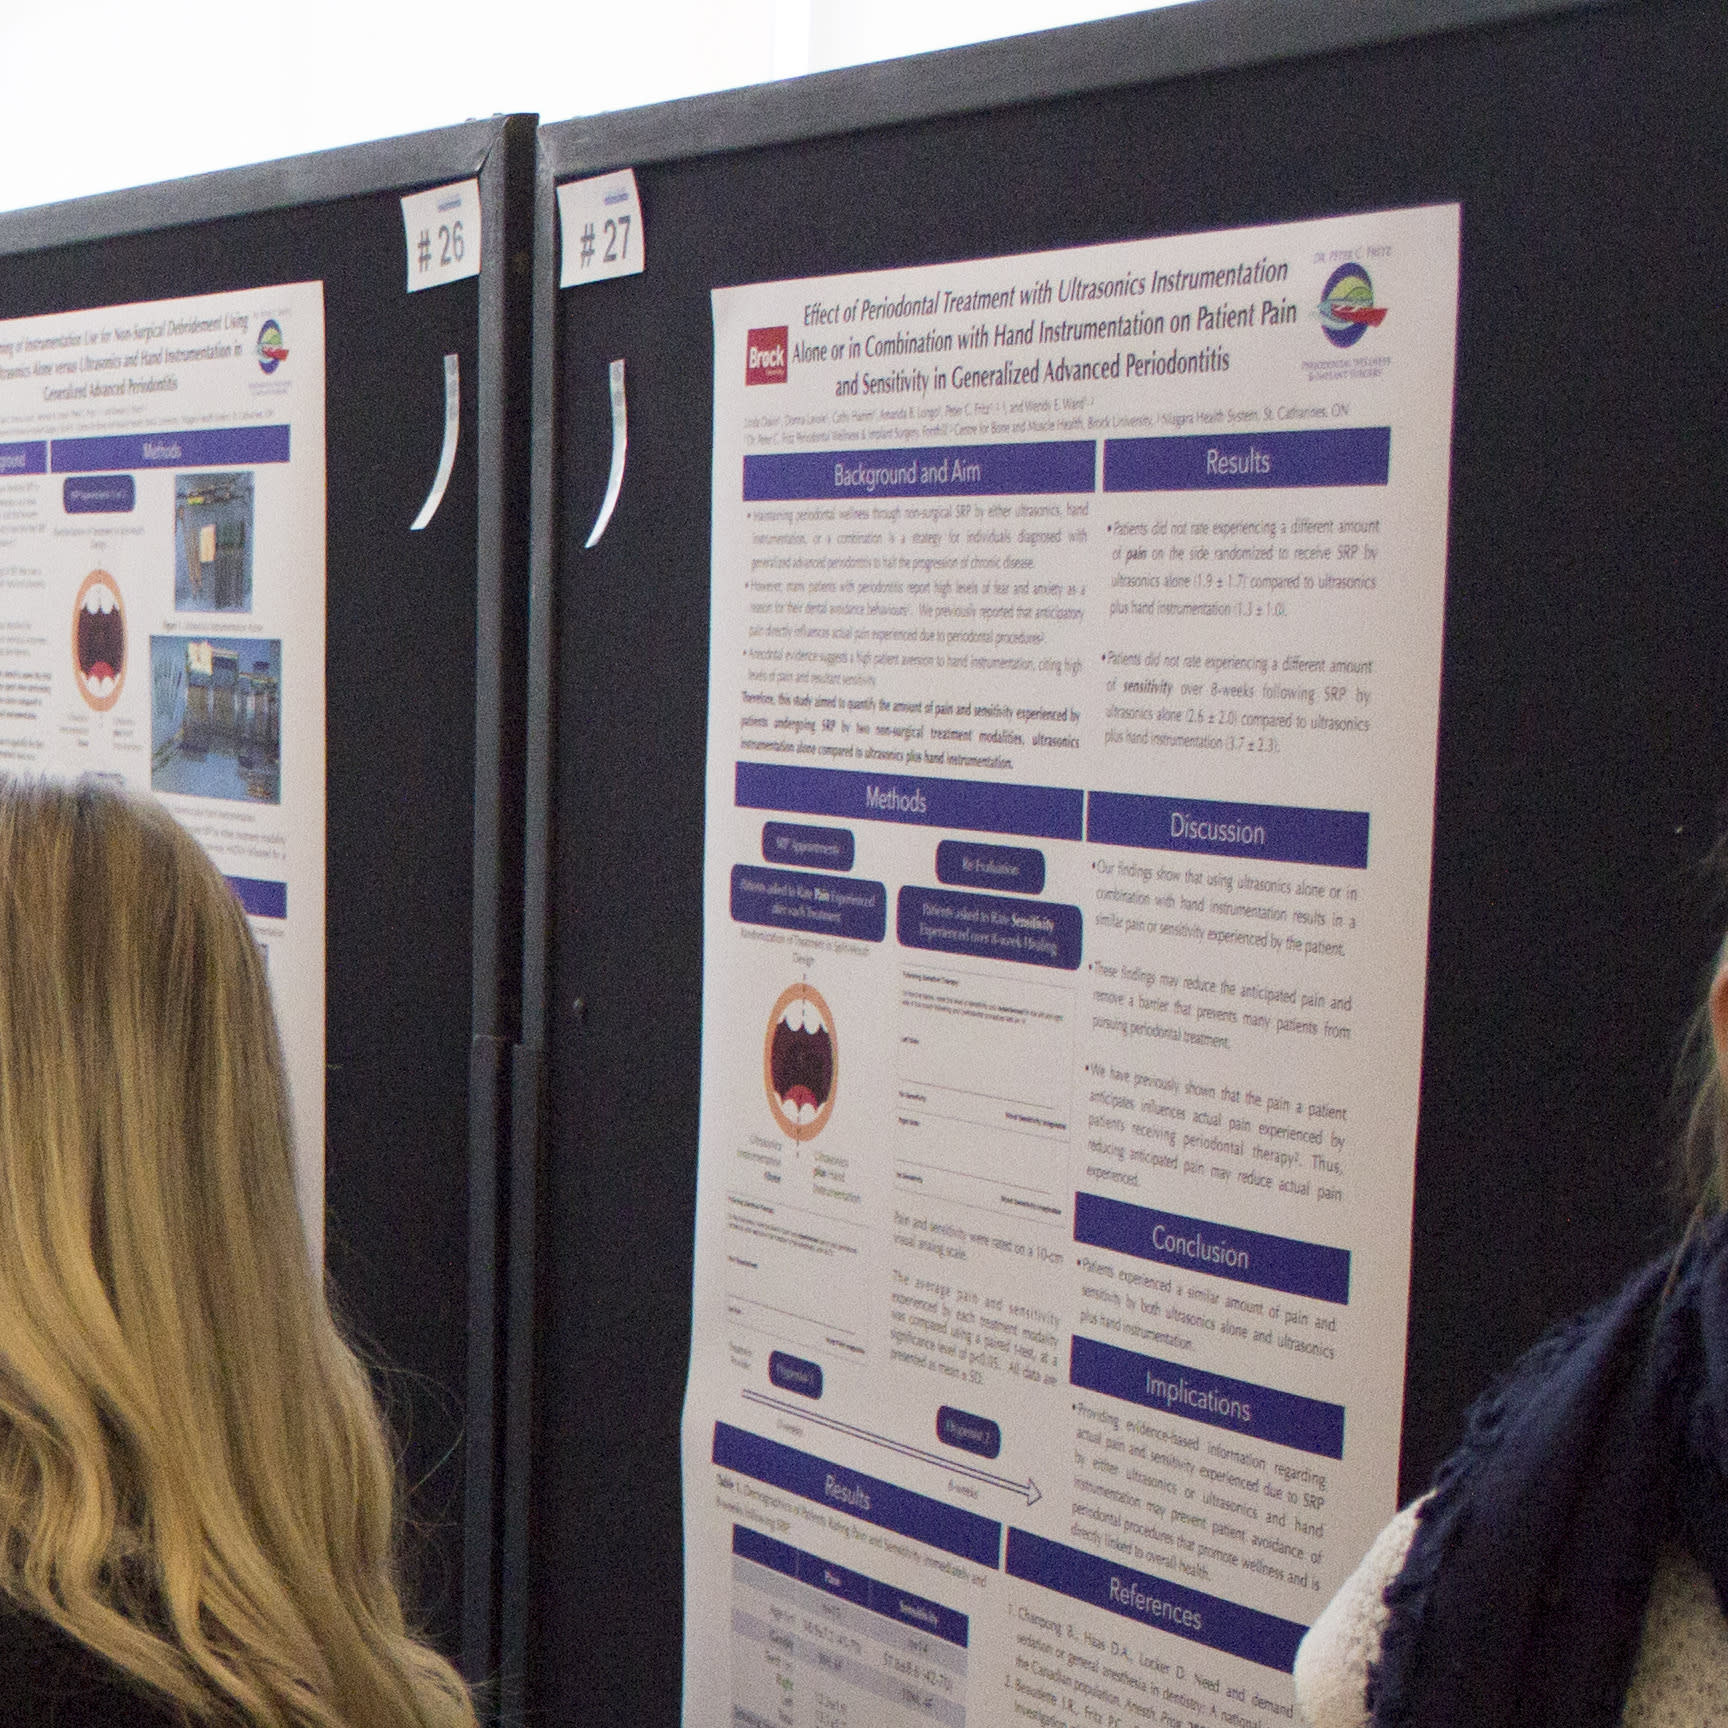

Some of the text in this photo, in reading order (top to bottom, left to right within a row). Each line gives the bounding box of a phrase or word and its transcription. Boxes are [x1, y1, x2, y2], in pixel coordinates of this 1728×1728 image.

[417, 220, 465, 273] # 26
[580, 215, 631, 269] # 27
[804, 257, 1288, 326] Effect of Periodontal Treatment with Ultrasonics Instrumentation
[792, 297, 1297, 363] Alone or in Combination with Hand Instrumentation on Patient Pain
[748, 348, 785, 369] Brock
[835, 346, 1230, 397] and Sensitivity in Generalized Advanced Periodontitis
[144, 442, 182, 459] Methods
[1207, 448, 1271, 474] Results
[834, 459, 981, 490] Background and Aim
[866, 785, 927, 813] Methods
[1171, 812, 1265, 844] Discussion
[1097, 859, 1357, 900] Our findings show that using ultrasonics alone or in
[1091, 1063, 1347, 1121] We have previously shown that the pain a patient
[1153, 1225, 1249, 1268] Conclusion
[1147, 1371, 1251, 1421] Implications
[825, 1473, 872, 1510] Results
[1110, 1577, 1201, 1629] References
